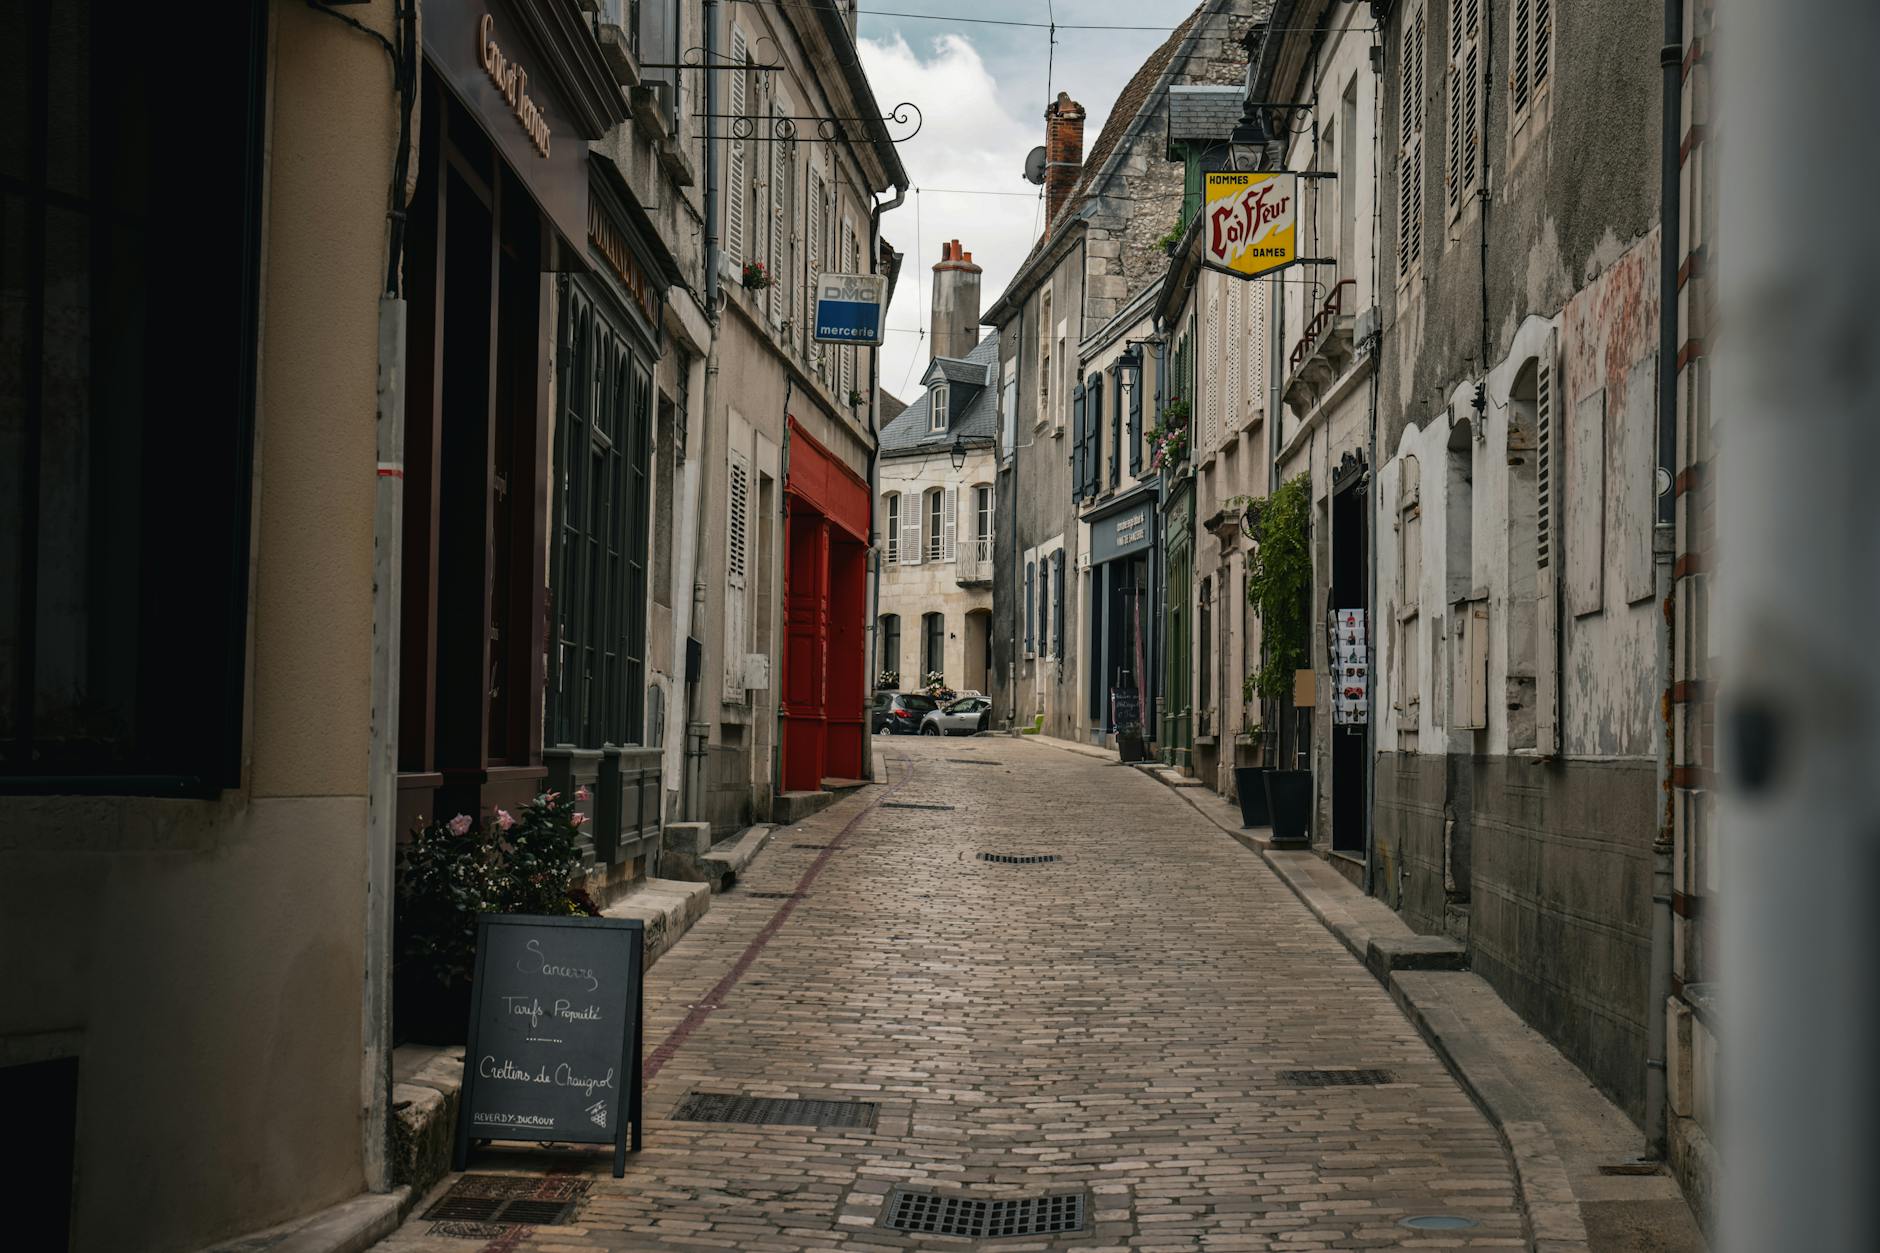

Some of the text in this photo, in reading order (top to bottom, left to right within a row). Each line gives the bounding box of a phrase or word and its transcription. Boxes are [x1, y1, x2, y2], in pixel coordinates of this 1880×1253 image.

[1209, 175, 1249, 184] HOMMES
[1212, 186, 1290, 259] Coiffeur
[1253, 248, 1286, 258] DAMES
[824, 286, 875, 301] DMC
[821, 326, 874, 337] mercerie
[516, 939, 599, 992] Sancerre
[501, 996, 603, 1028] Tarifs Propriété
[479, 1055, 531, 1084] Crottins
[533, 1064, 551, 1084] de
[474, 1111, 554, 1126] REVERDY-DUCROUX
